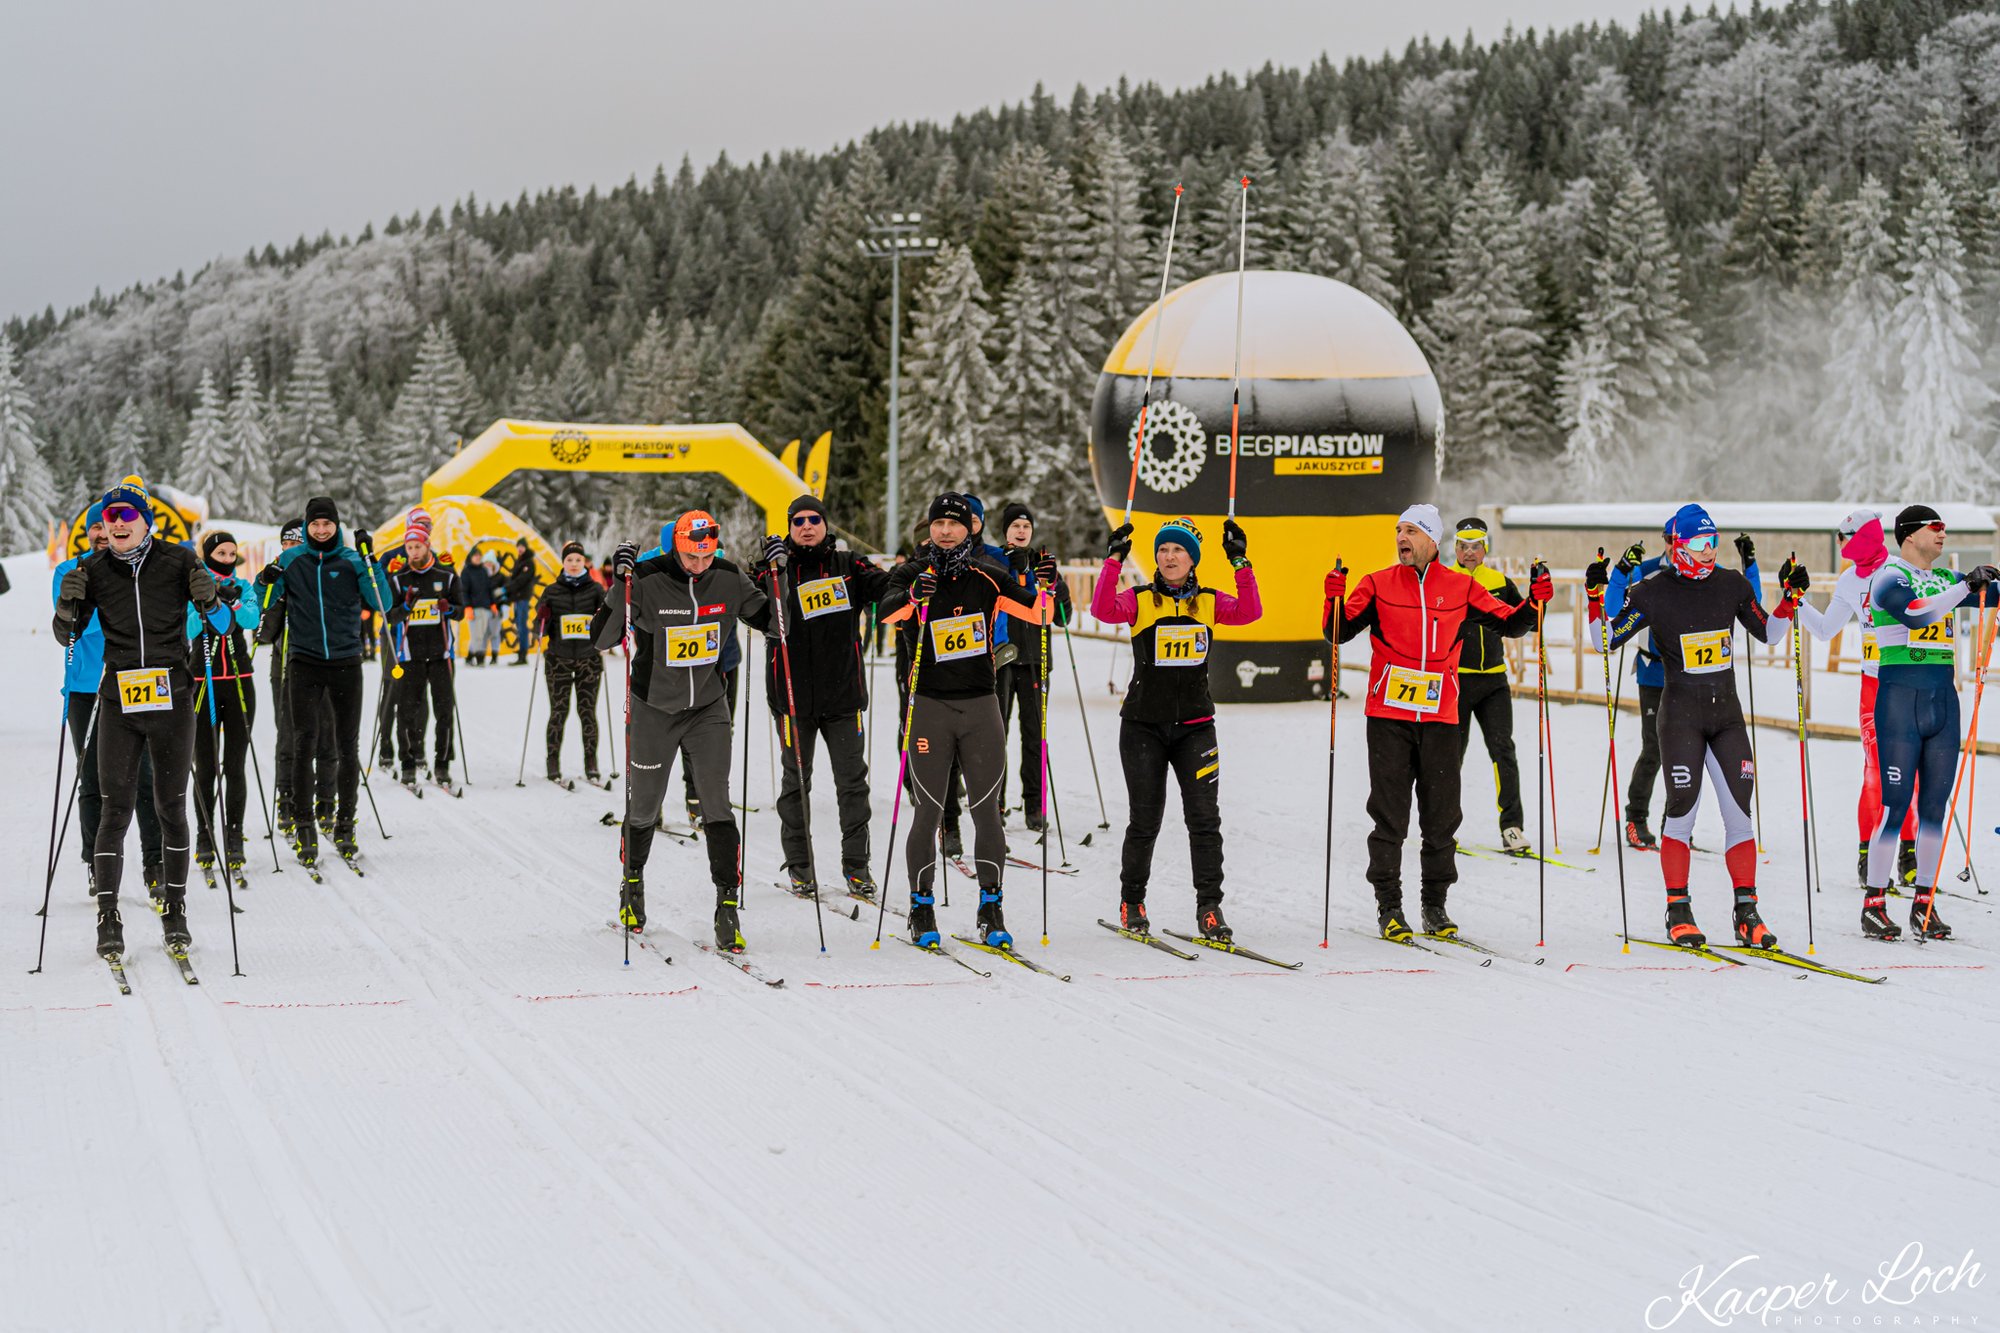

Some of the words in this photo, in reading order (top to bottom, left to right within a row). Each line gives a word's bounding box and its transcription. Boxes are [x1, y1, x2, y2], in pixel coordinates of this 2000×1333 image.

[1215, 433, 1384, 456] BEGPIASTÓW
[1295, 461, 1367, 471] JAKUSZYCE
[806, 591, 831, 609] 118
[565, 623, 583, 633] 116
[1918, 625, 1939, 640] 22
[677, 641, 699, 658] 20
[944, 632, 967, 651] 66
[1164, 641, 1189, 658] 111
[1695, 647, 1713, 665] 12
[125, 686, 151, 703] 121
[1397, 684, 1417, 701] 71
